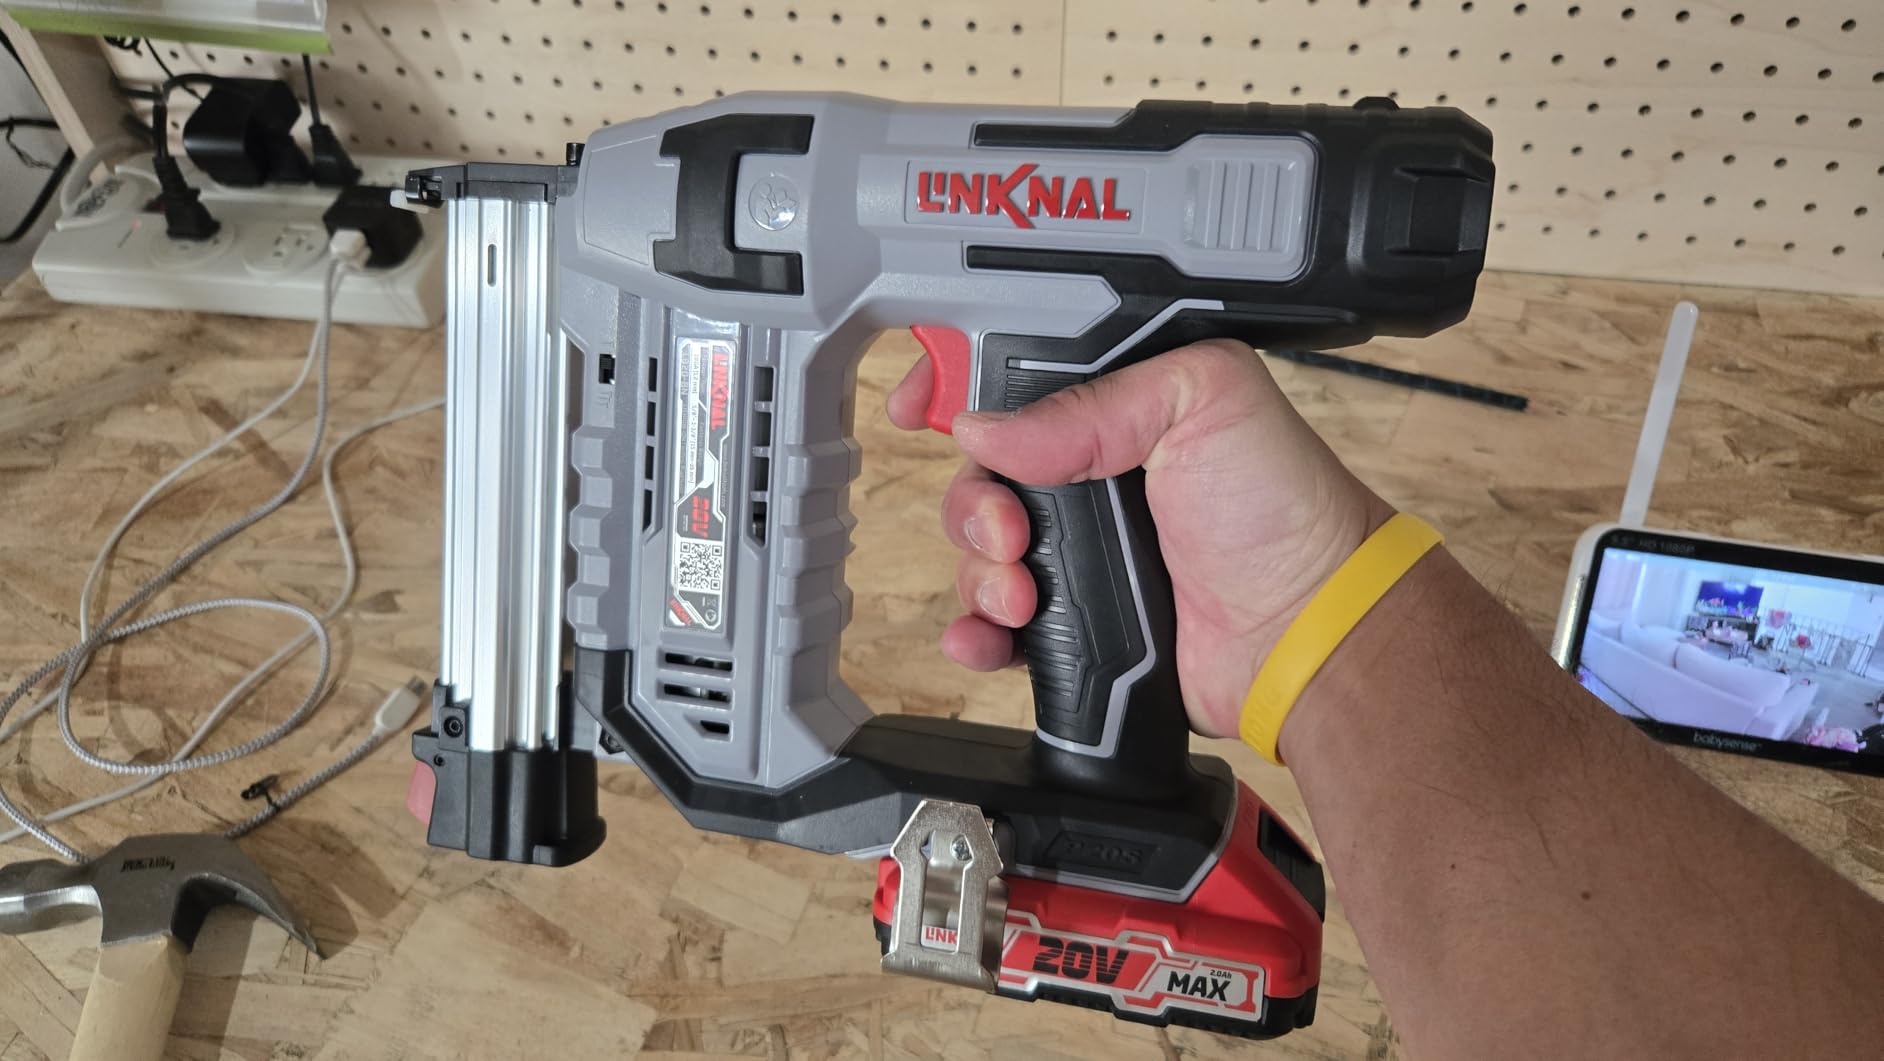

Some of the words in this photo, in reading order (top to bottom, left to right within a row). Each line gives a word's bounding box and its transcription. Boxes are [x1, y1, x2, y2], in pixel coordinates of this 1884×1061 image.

[916, 162, 1131, 229] LINKNAL
[710, 352, 730, 431] LINKNAL
[690, 496, 710, 538] 20V
[1693, 731, 1758, 752] babysense
[1032, 936, 1130, 985] 20V
[1209, 968, 1233, 980] 2.0Ah
[1166, 969, 1232, 1003] MAX
